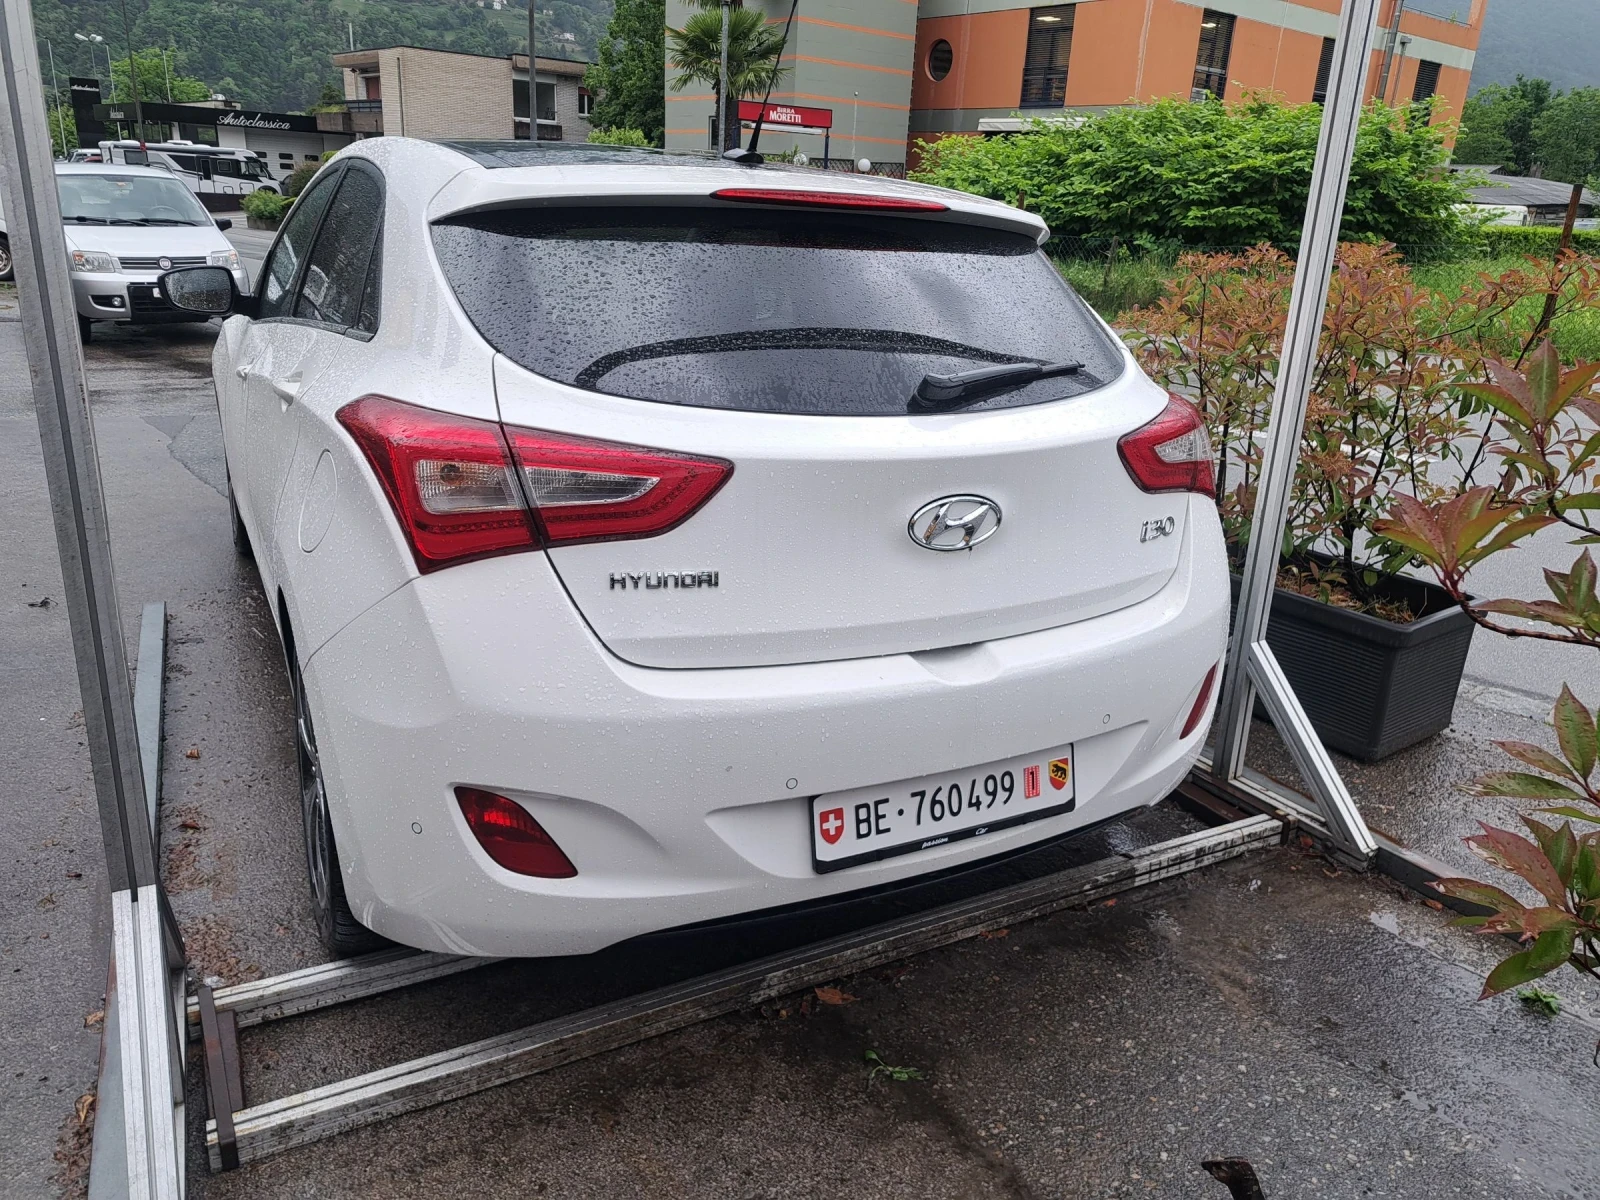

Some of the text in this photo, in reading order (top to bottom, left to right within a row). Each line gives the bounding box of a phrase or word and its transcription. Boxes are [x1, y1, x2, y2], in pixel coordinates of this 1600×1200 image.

[769, 110, 801, 123] MORETTI
[777, 106, 795, 114] BIRRA
[217, 112, 290, 130] Autoclassica
[1140, 516, 1175, 543] i30
[609, 570, 719, 590] HYUNDAI
